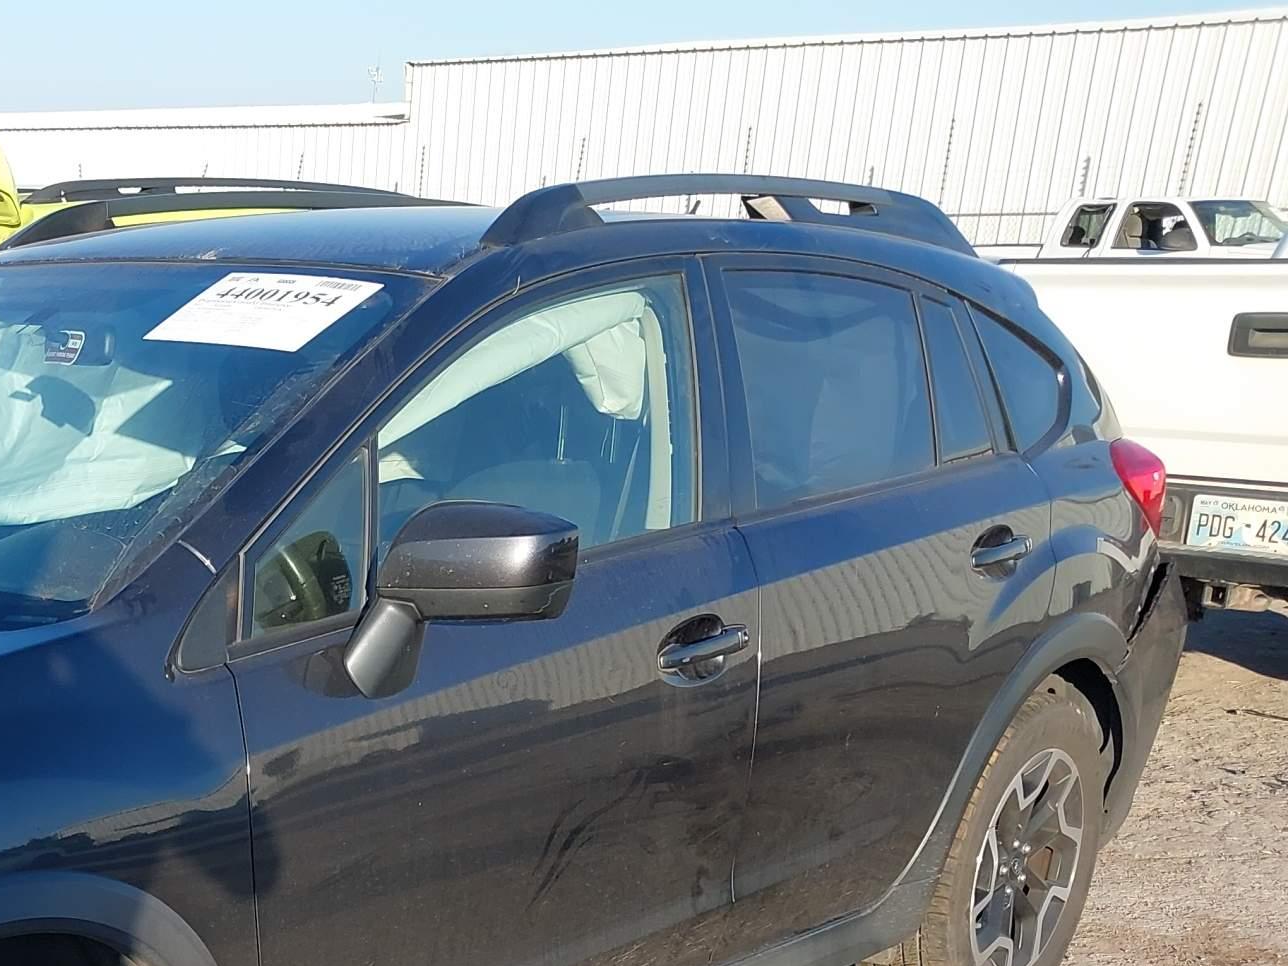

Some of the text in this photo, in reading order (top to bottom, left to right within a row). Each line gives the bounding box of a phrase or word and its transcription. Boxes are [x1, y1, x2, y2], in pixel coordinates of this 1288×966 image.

[216, 286, 343, 307] 44001954
[1221, 502, 1278, 514] OKLAHOMA
[1196, 512, 1236, 539] PDG
